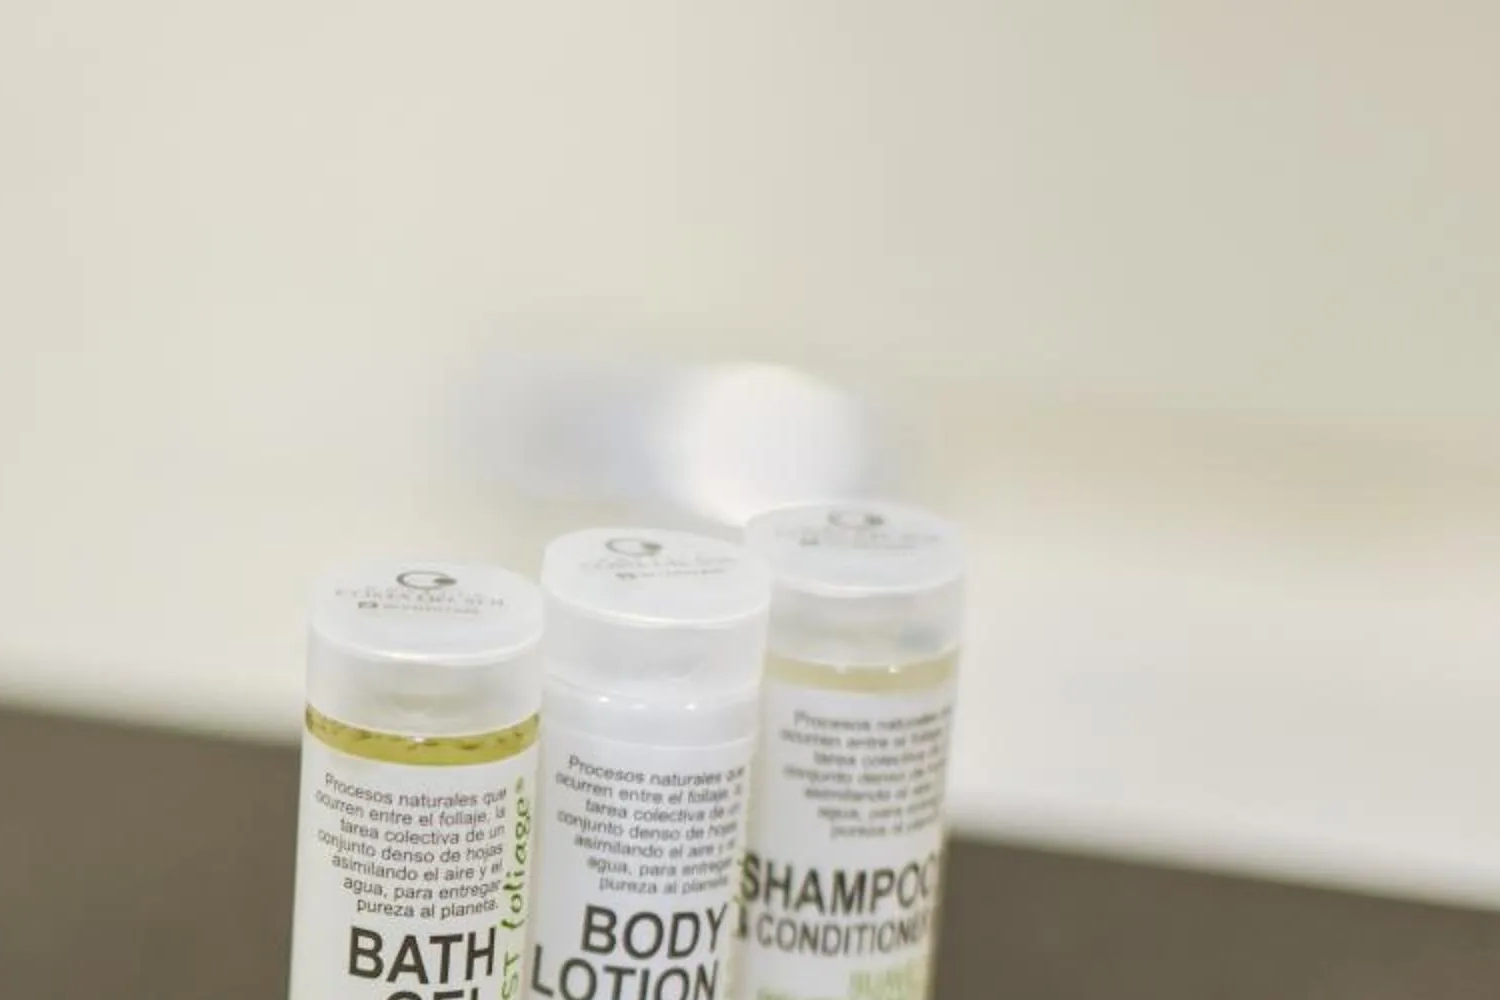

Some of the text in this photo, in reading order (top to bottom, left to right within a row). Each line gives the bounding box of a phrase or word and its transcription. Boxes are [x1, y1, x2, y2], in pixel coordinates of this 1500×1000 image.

[569, 755, 644, 783] Procesos
[325, 772, 393, 805] Procesos
[399, 790, 478, 808] naturales
[555, 772, 613, 797] ocurren
[619, 787, 663, 804] entre
[314, 789, 364, 819] ocurren
[369, 807, 413, 825] entre
[419, 811, 433, 826] el
[586, 799, 627, 818] tarea
[340, 818, 505, 845] tarea colectiva de un
[557, 810, 624, 836] conjunto
[628, 825, 680, 841] denso
[317, 828, 503, 864] conjunto denso de hojas
[332, 853, 418, 881] asimilando
[424, 866, 439, 881] el
[444, 864, 474, 881] aire
[479, 866, 487, 882] y
[343, 876, 502, 905] agua, para entregar
[356, 898, 414, 919] pureza
[420, 903, 435, 918] al
[580, 903, 728, 960] BODY
[347, 925, 497, 985] BATH
